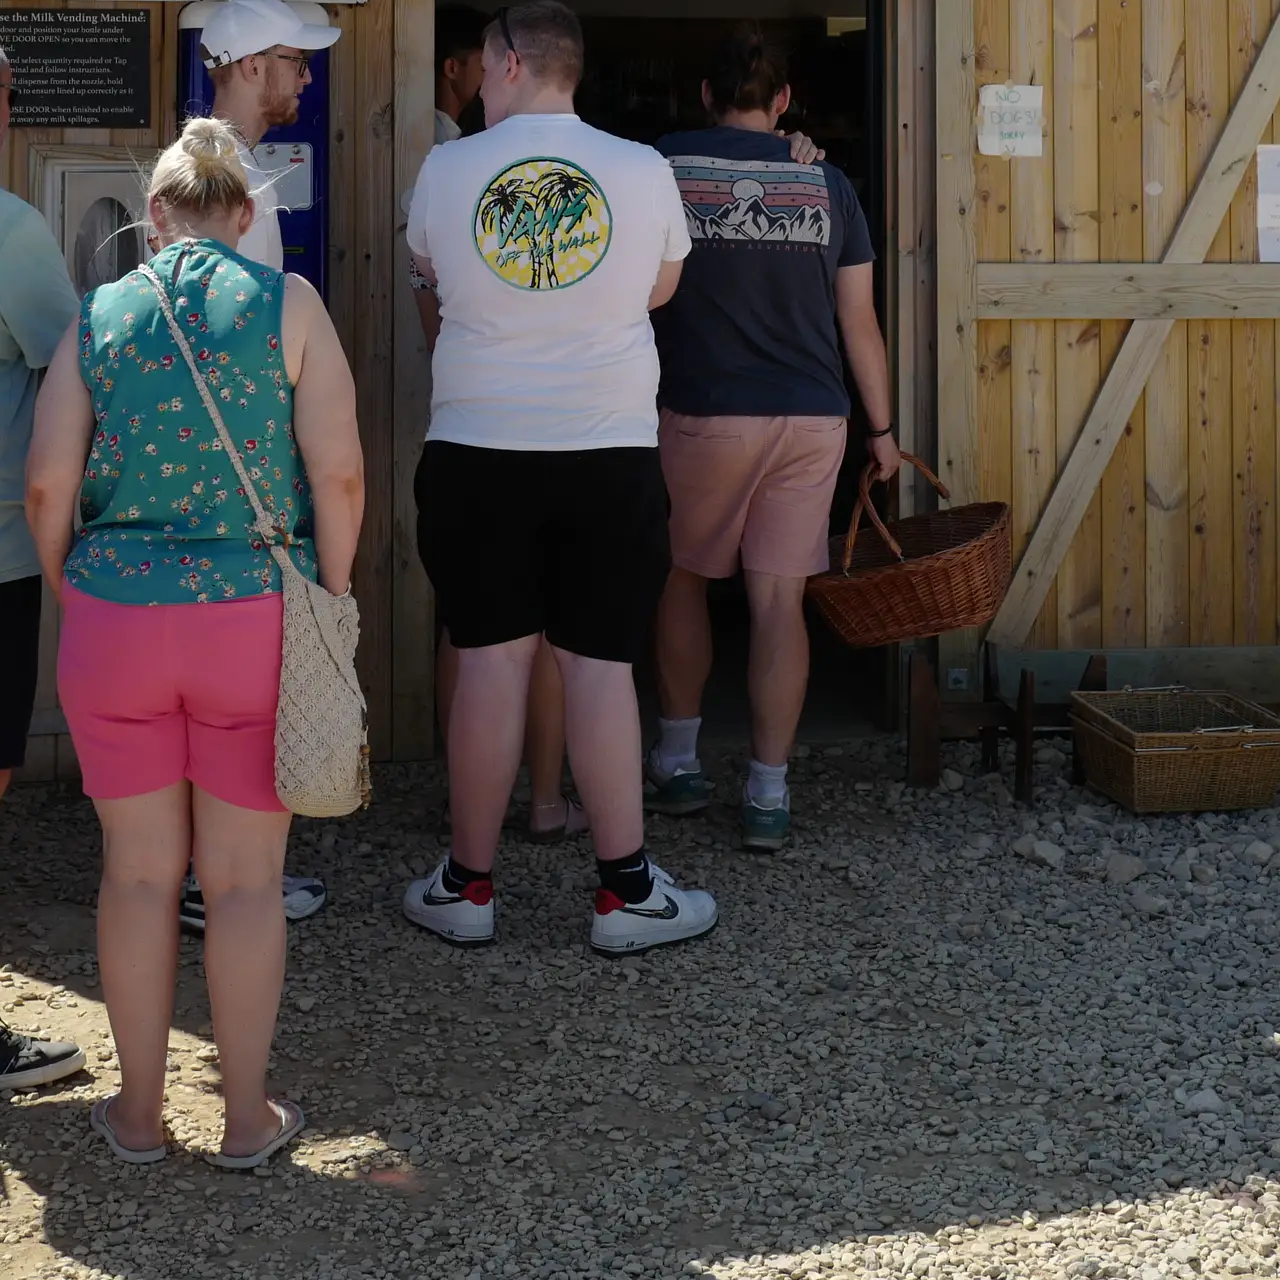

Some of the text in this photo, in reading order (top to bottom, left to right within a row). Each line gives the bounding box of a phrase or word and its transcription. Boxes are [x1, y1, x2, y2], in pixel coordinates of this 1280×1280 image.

[12, 12, 28, 22] the
[31, 12, 55, 22] Milk
[56, 13, 98, 25] Vending
[100, 13, 146, 23] Machine:
[0, 25, 18, 33] door
[18, 26, 32, 34] and
[33, 25, 62, 35] position
[63, 27, 80, 35] your
[81, 26, 101, 34] bottle
[102, 26, 125, 34] under
[12, 35, 36, 43] DOOR
[37, 35, 60, 43] OPEN
[70, 37, 84, 45] you
[119, 35, 132, 43] the
[21, 56, 41, 64] select
[42, 57, 71, 66] quantity
[73, 56, 103, 66] required
[113, 57, 127, 66] Tap
[17, 77, 49, 86] dispense
[81, 77, 106, 85] nozzle,
[86, 87, 118, 95] correctly
[995, 90, 1021, 104] NO
[72, 105, 101, 113] finished
[50, 115, 67, 123] milk
[68, 115, 100, 125] spillages.
[990, 109, 1037, 125] DOGS!
[999, 131, 1025, 141] SORRY
[492, 189, 588, 249] VANS
[496, 250, 523, 268] OFF
[558, 231, 601, 253] WALL
[693, 242, 735, 250] NTAIN
